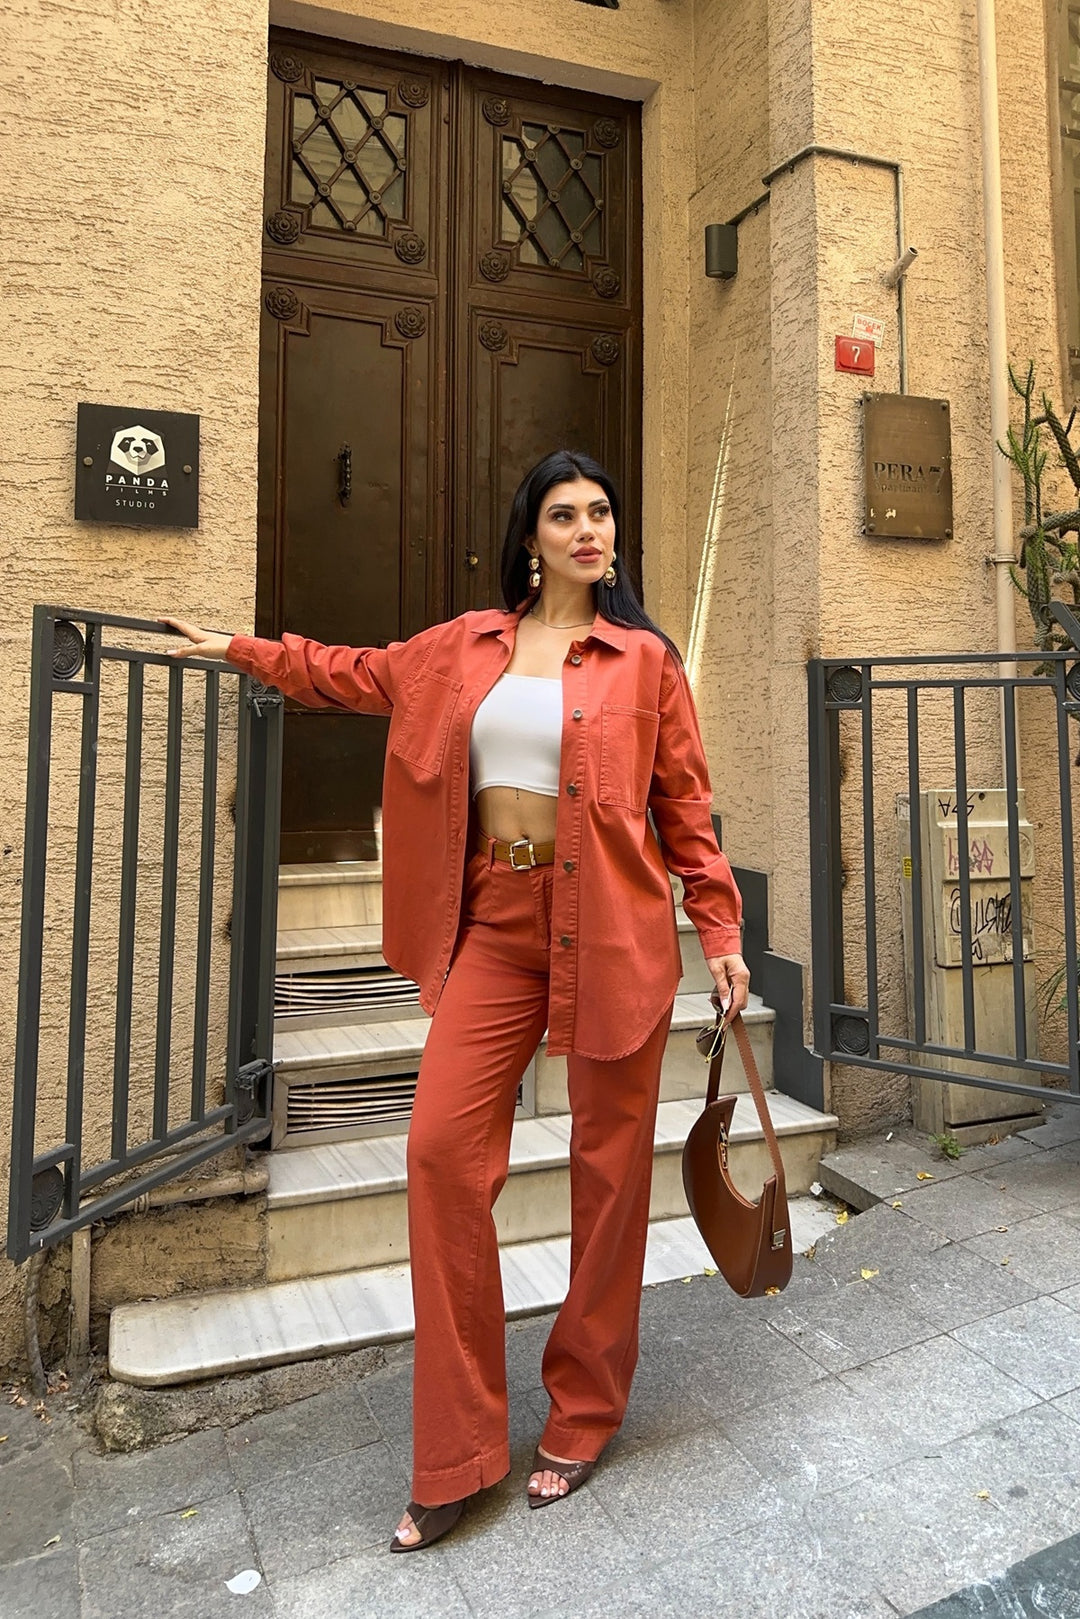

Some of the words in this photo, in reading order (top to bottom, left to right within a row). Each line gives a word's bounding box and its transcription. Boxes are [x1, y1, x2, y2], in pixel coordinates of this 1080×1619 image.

[851, 345, 861, 364] 7
[873, 461, 926, 483] PERA
[105, 474, 169, 488] PANDA
[115, 498, 155, 509] STUDIO
